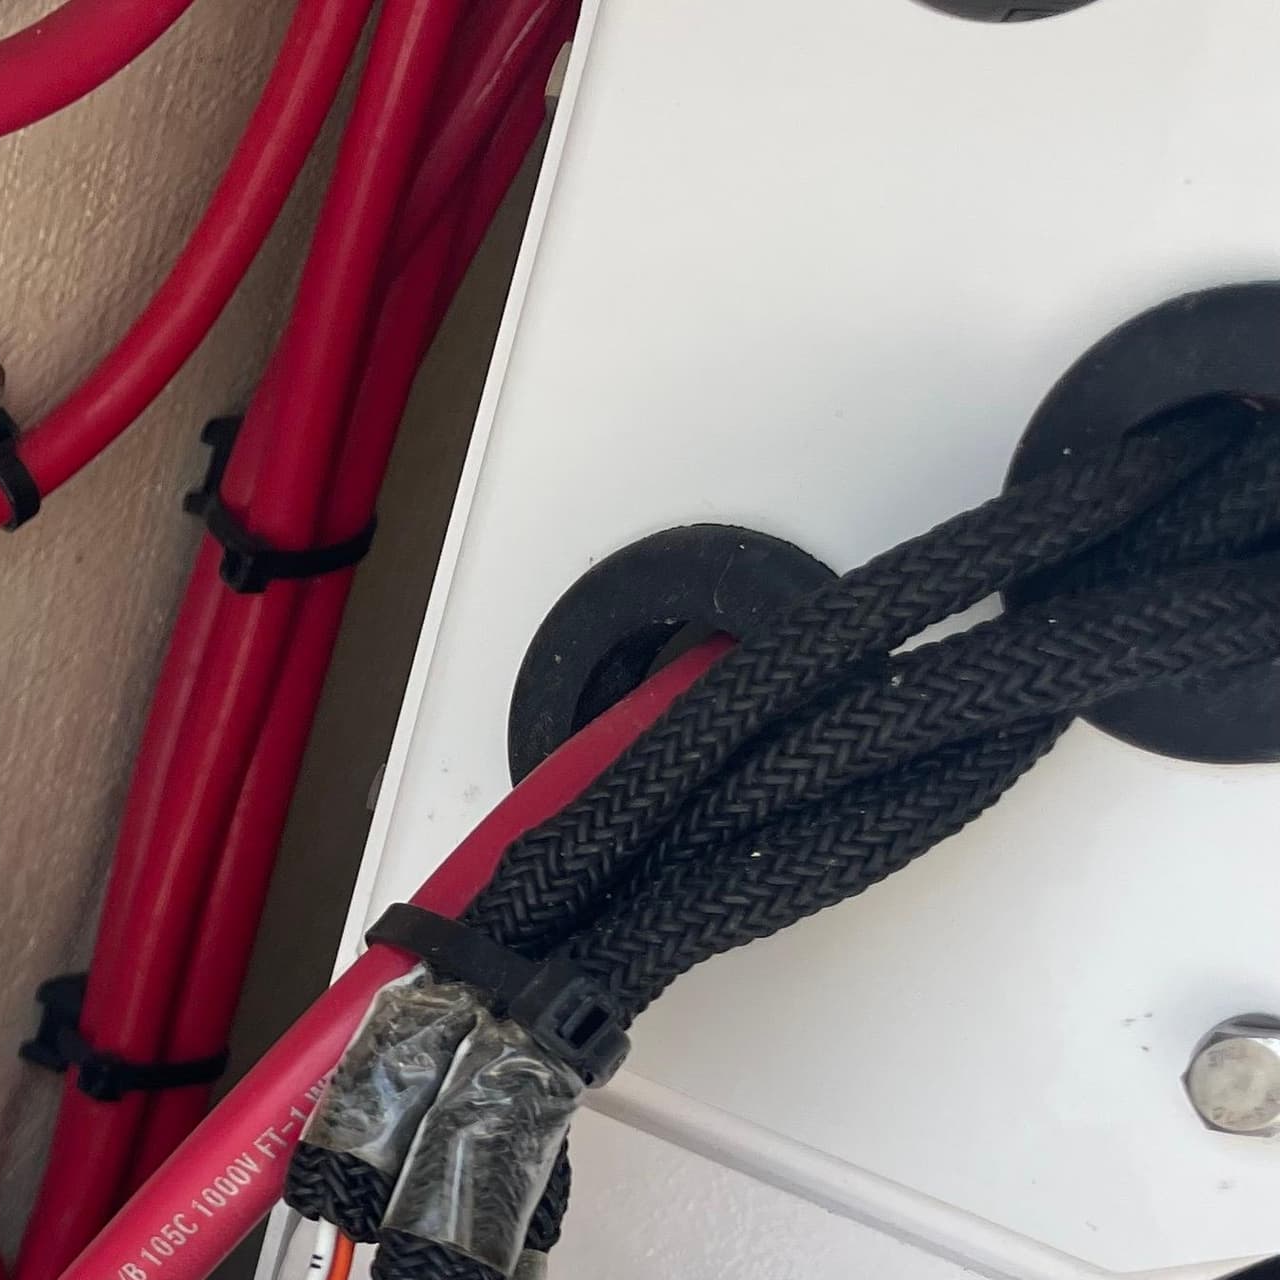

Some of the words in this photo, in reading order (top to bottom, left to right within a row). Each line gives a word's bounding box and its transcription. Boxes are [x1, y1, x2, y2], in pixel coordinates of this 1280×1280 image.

[140, 1212, 199, 1267] 105C
[191, 1151, 262, 1218] 1000V
[253, 1105, 307, 1160] FT-1
